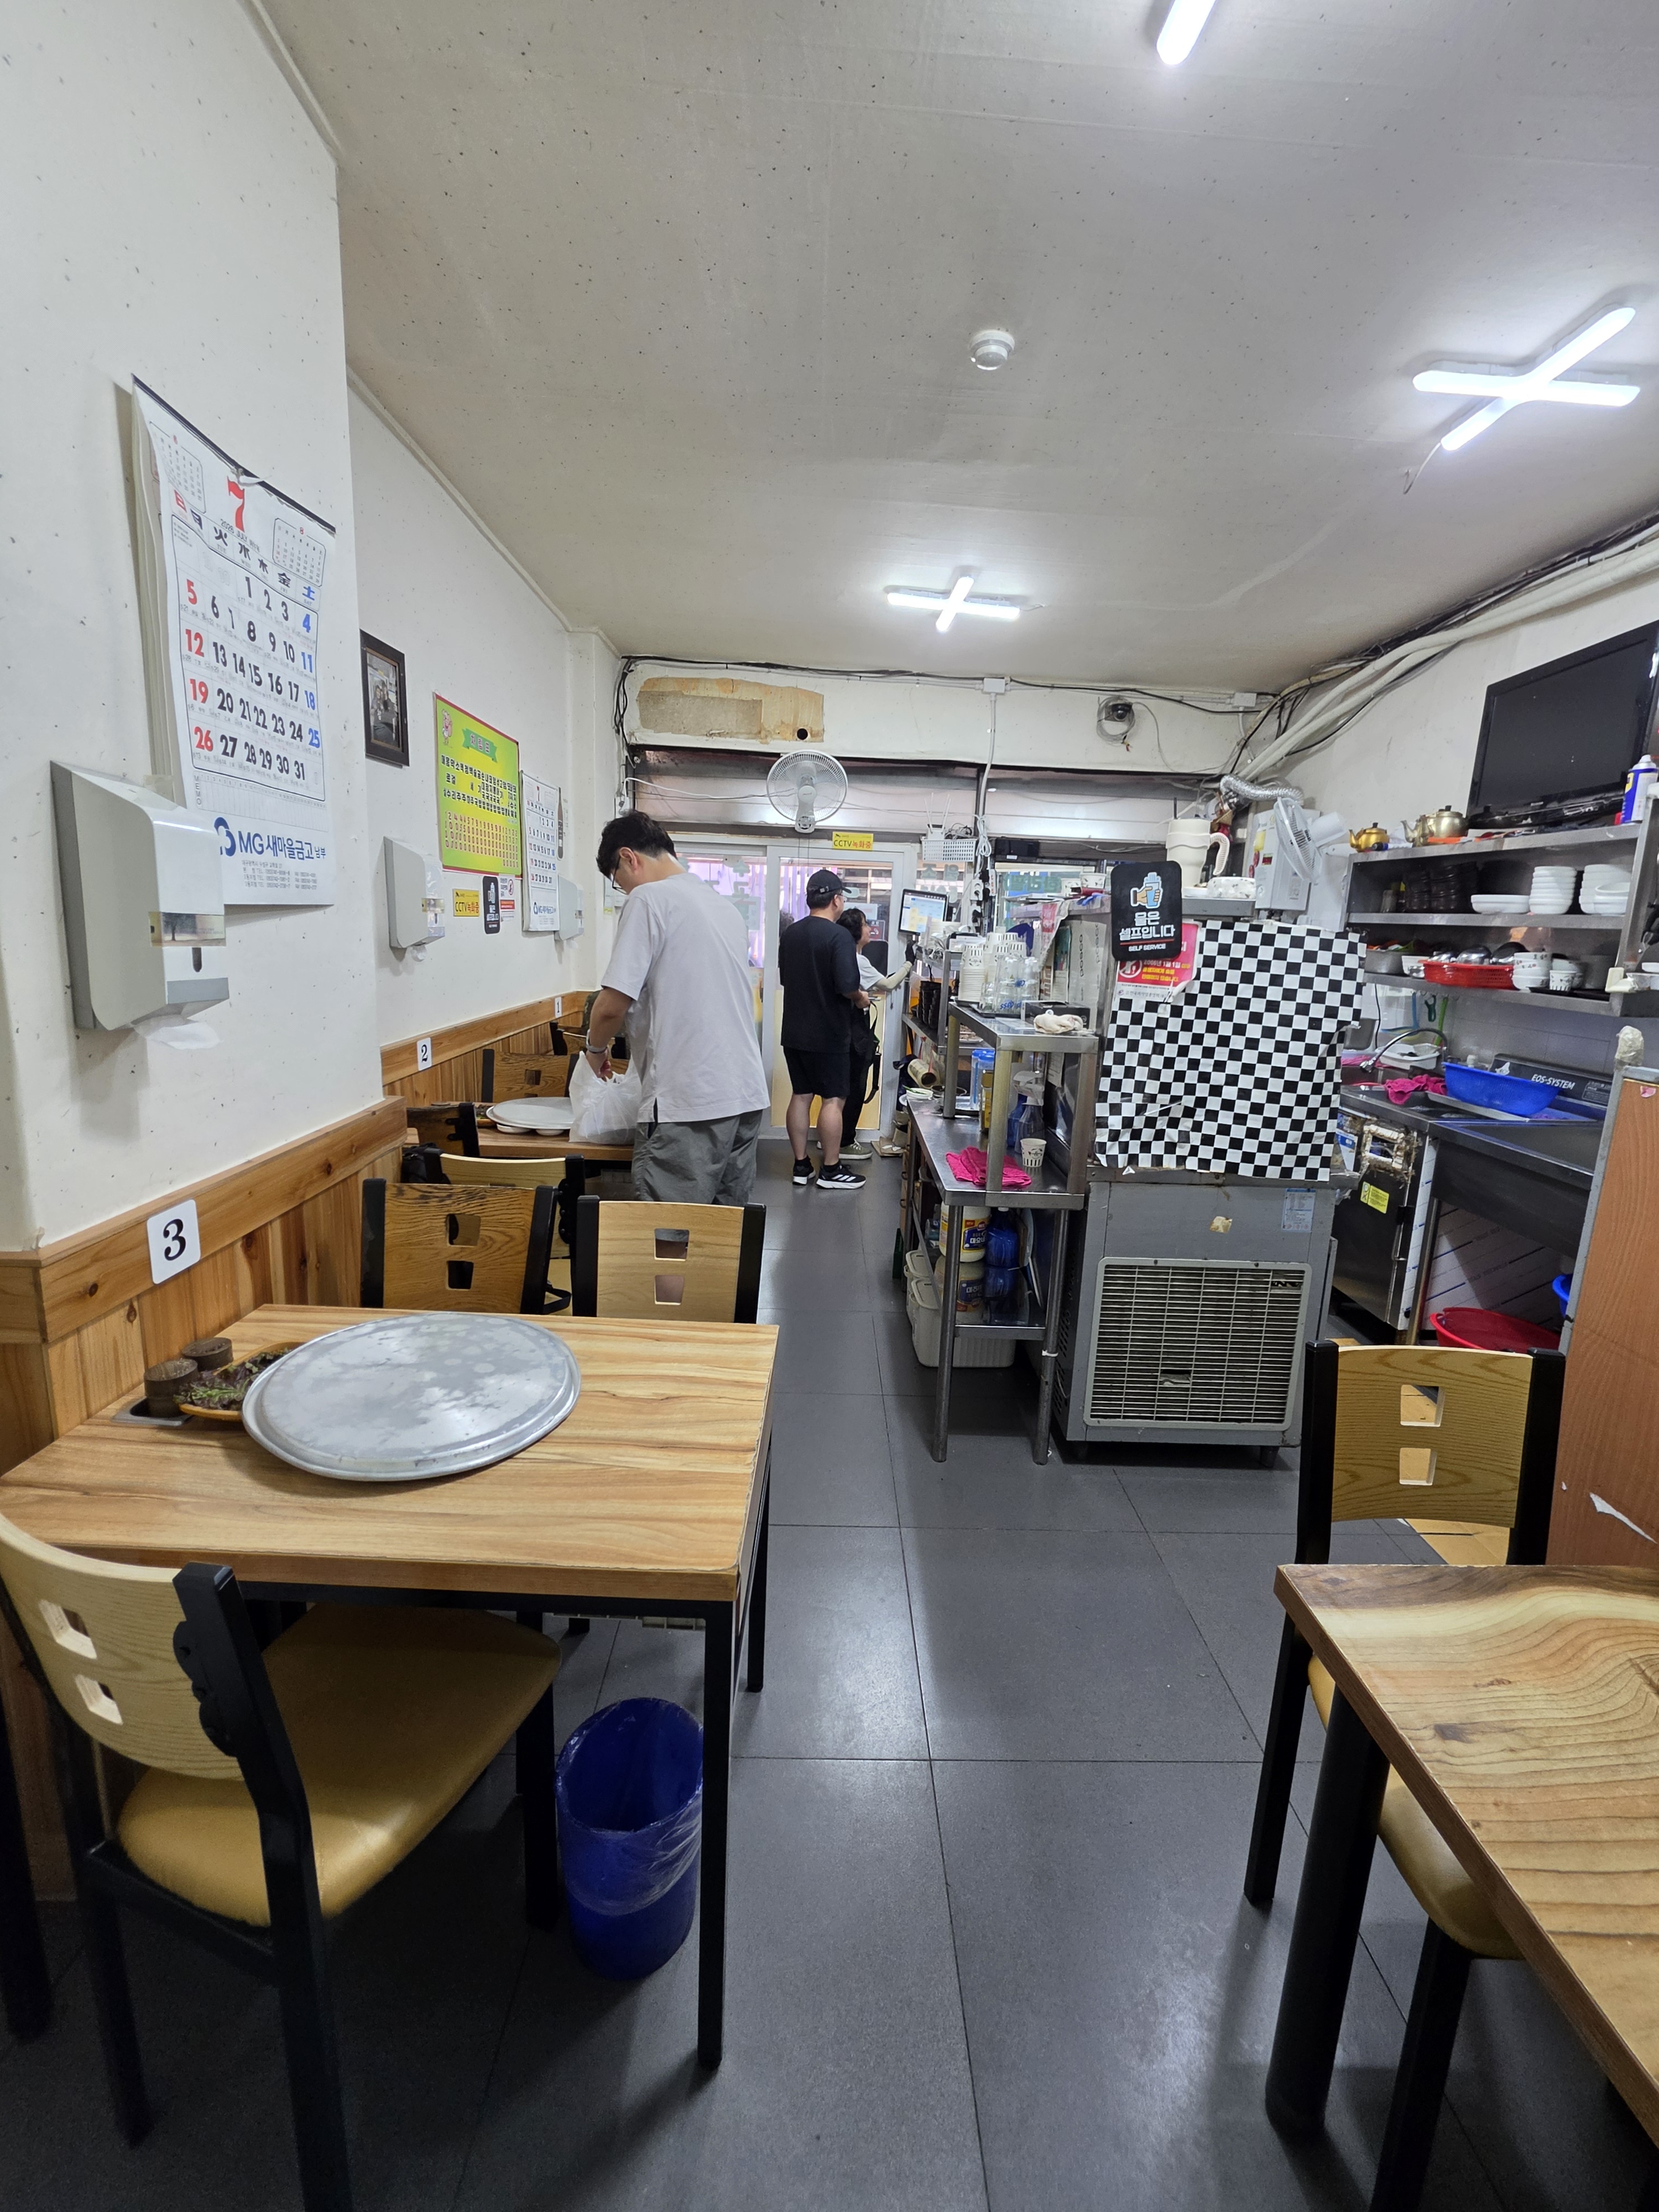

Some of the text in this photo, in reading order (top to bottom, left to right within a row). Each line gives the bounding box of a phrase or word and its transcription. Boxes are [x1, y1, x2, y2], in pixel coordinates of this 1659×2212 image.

[227, 476, 245, 533] 7
[237, 531, 247, 541] JULY
[213, 526, 228, 546] 火
[238, 542, 251, 560] 水
[258, 559, 268, 574] 木
[278, 572, 291, 588] 金
[302, 586, 315, 601] 土
[245, 576, 311, 633] 1 2 3 4
[186, 578, 197, 605] 5
[211, 595, 220, 619] 6
[247, 620, 257, 642] 8
[269, 632, 276, 652] 9
[283, 640, 295, 663] 10
[301, 651, 312, 673] 11
[185, 628, 205, 658] 12
[212, 641, 227, 667] 13
[232, 653, 246, 678] 14
[248, 662, 262, 686] 15
[268, 672, 283, 695] 16
[288, 681, 299, 702] 17
[304, 690, 316, 711] 18
[190, 678, 320, 749] 19 20 21 22 23 24 25
[194, 726, 305, 780] 26 27 28 29 30 31
[314, 846, 326, 859] 남부
[1119, 925, 1176, 941] 셀프입니다
[1134, 911, 1160, 926] 물은
[1143, 943, 1166, 951] SERVICE
[556, 1001, 560, 1013] 1
[421, 1044, 428, 1063] 2
[1531, 1074, 1575, 1090] EOS-SYSTEM
[163, 1218, 186, 1261] 3
